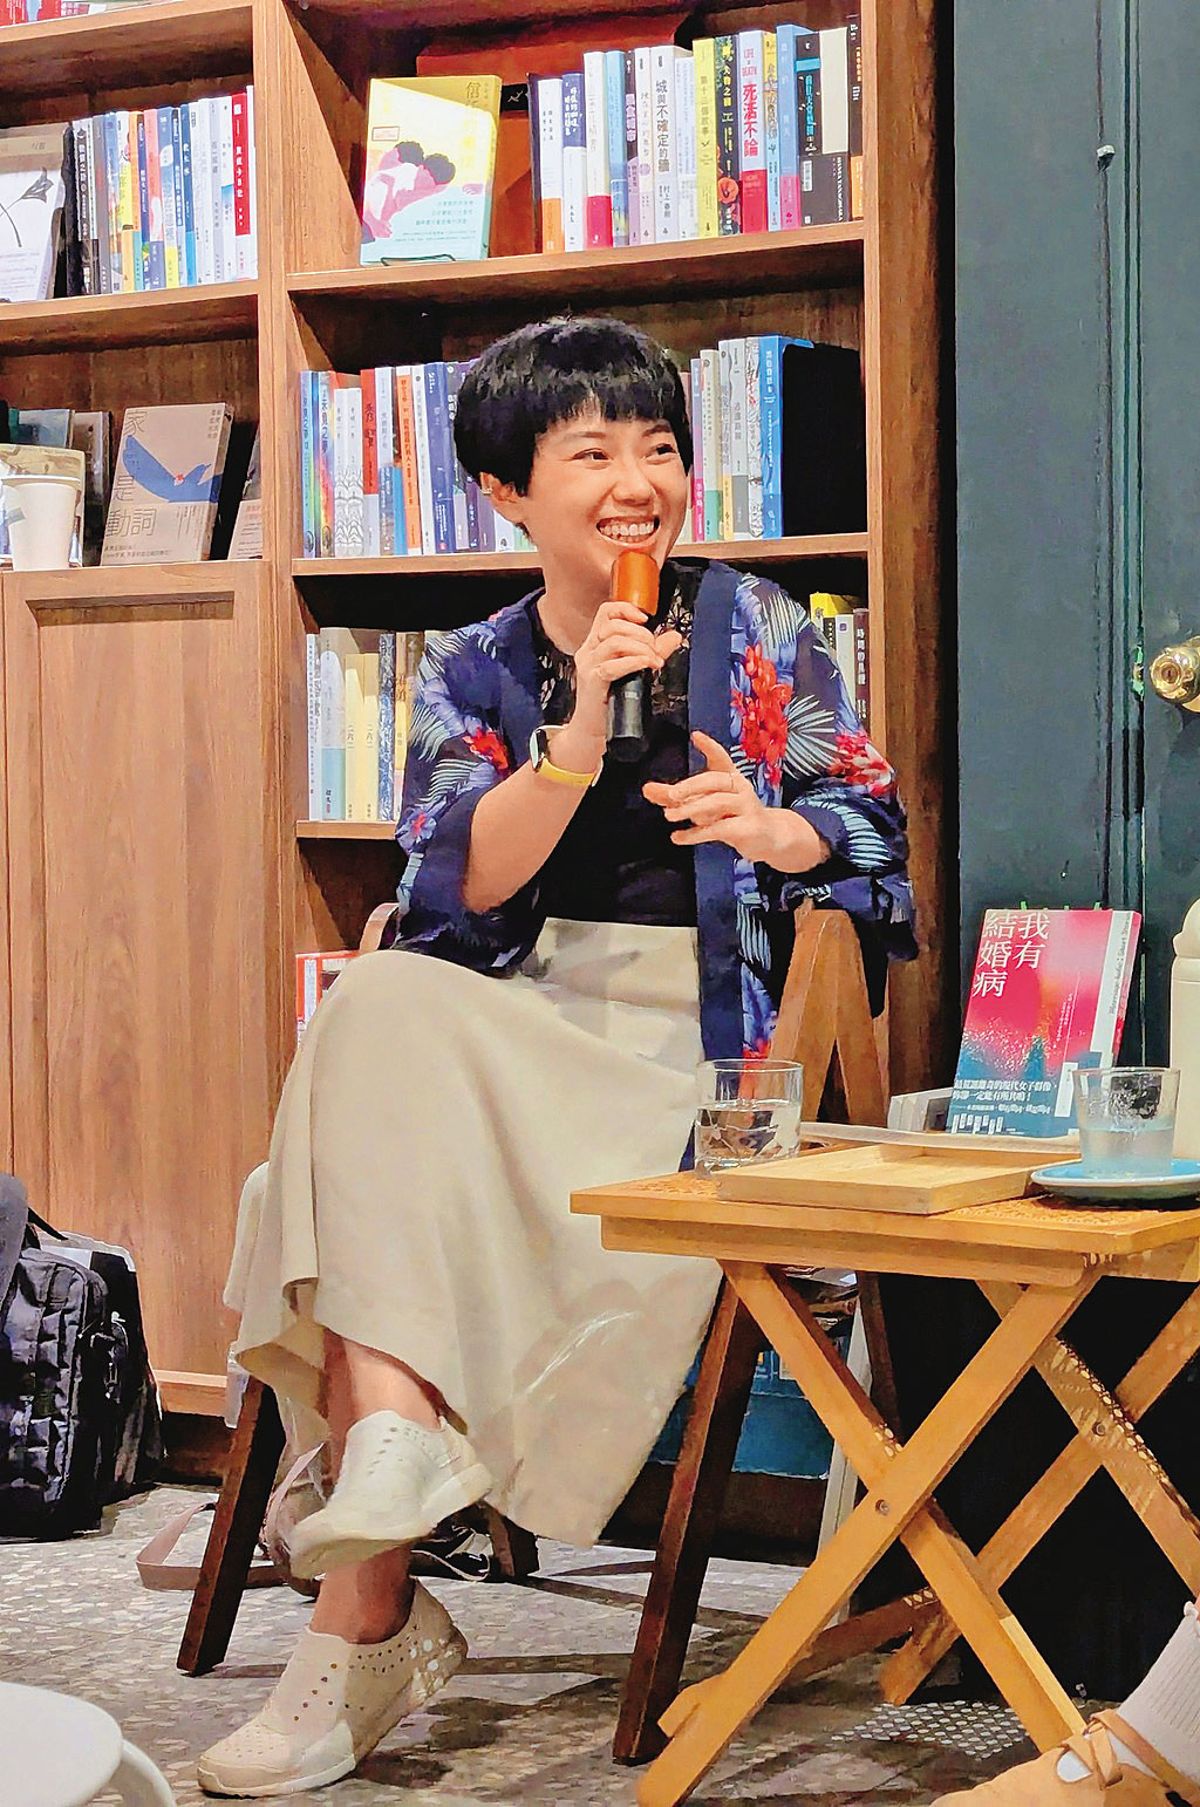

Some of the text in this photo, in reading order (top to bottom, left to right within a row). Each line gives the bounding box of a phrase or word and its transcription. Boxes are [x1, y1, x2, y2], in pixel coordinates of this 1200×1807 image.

[742, 83, 759, 157] 死活不論
[105, 508, 157, 537] 動詞
[973, 912, 1014, 997] 結婚病
[1014, 912, 1050, 969] 我有
